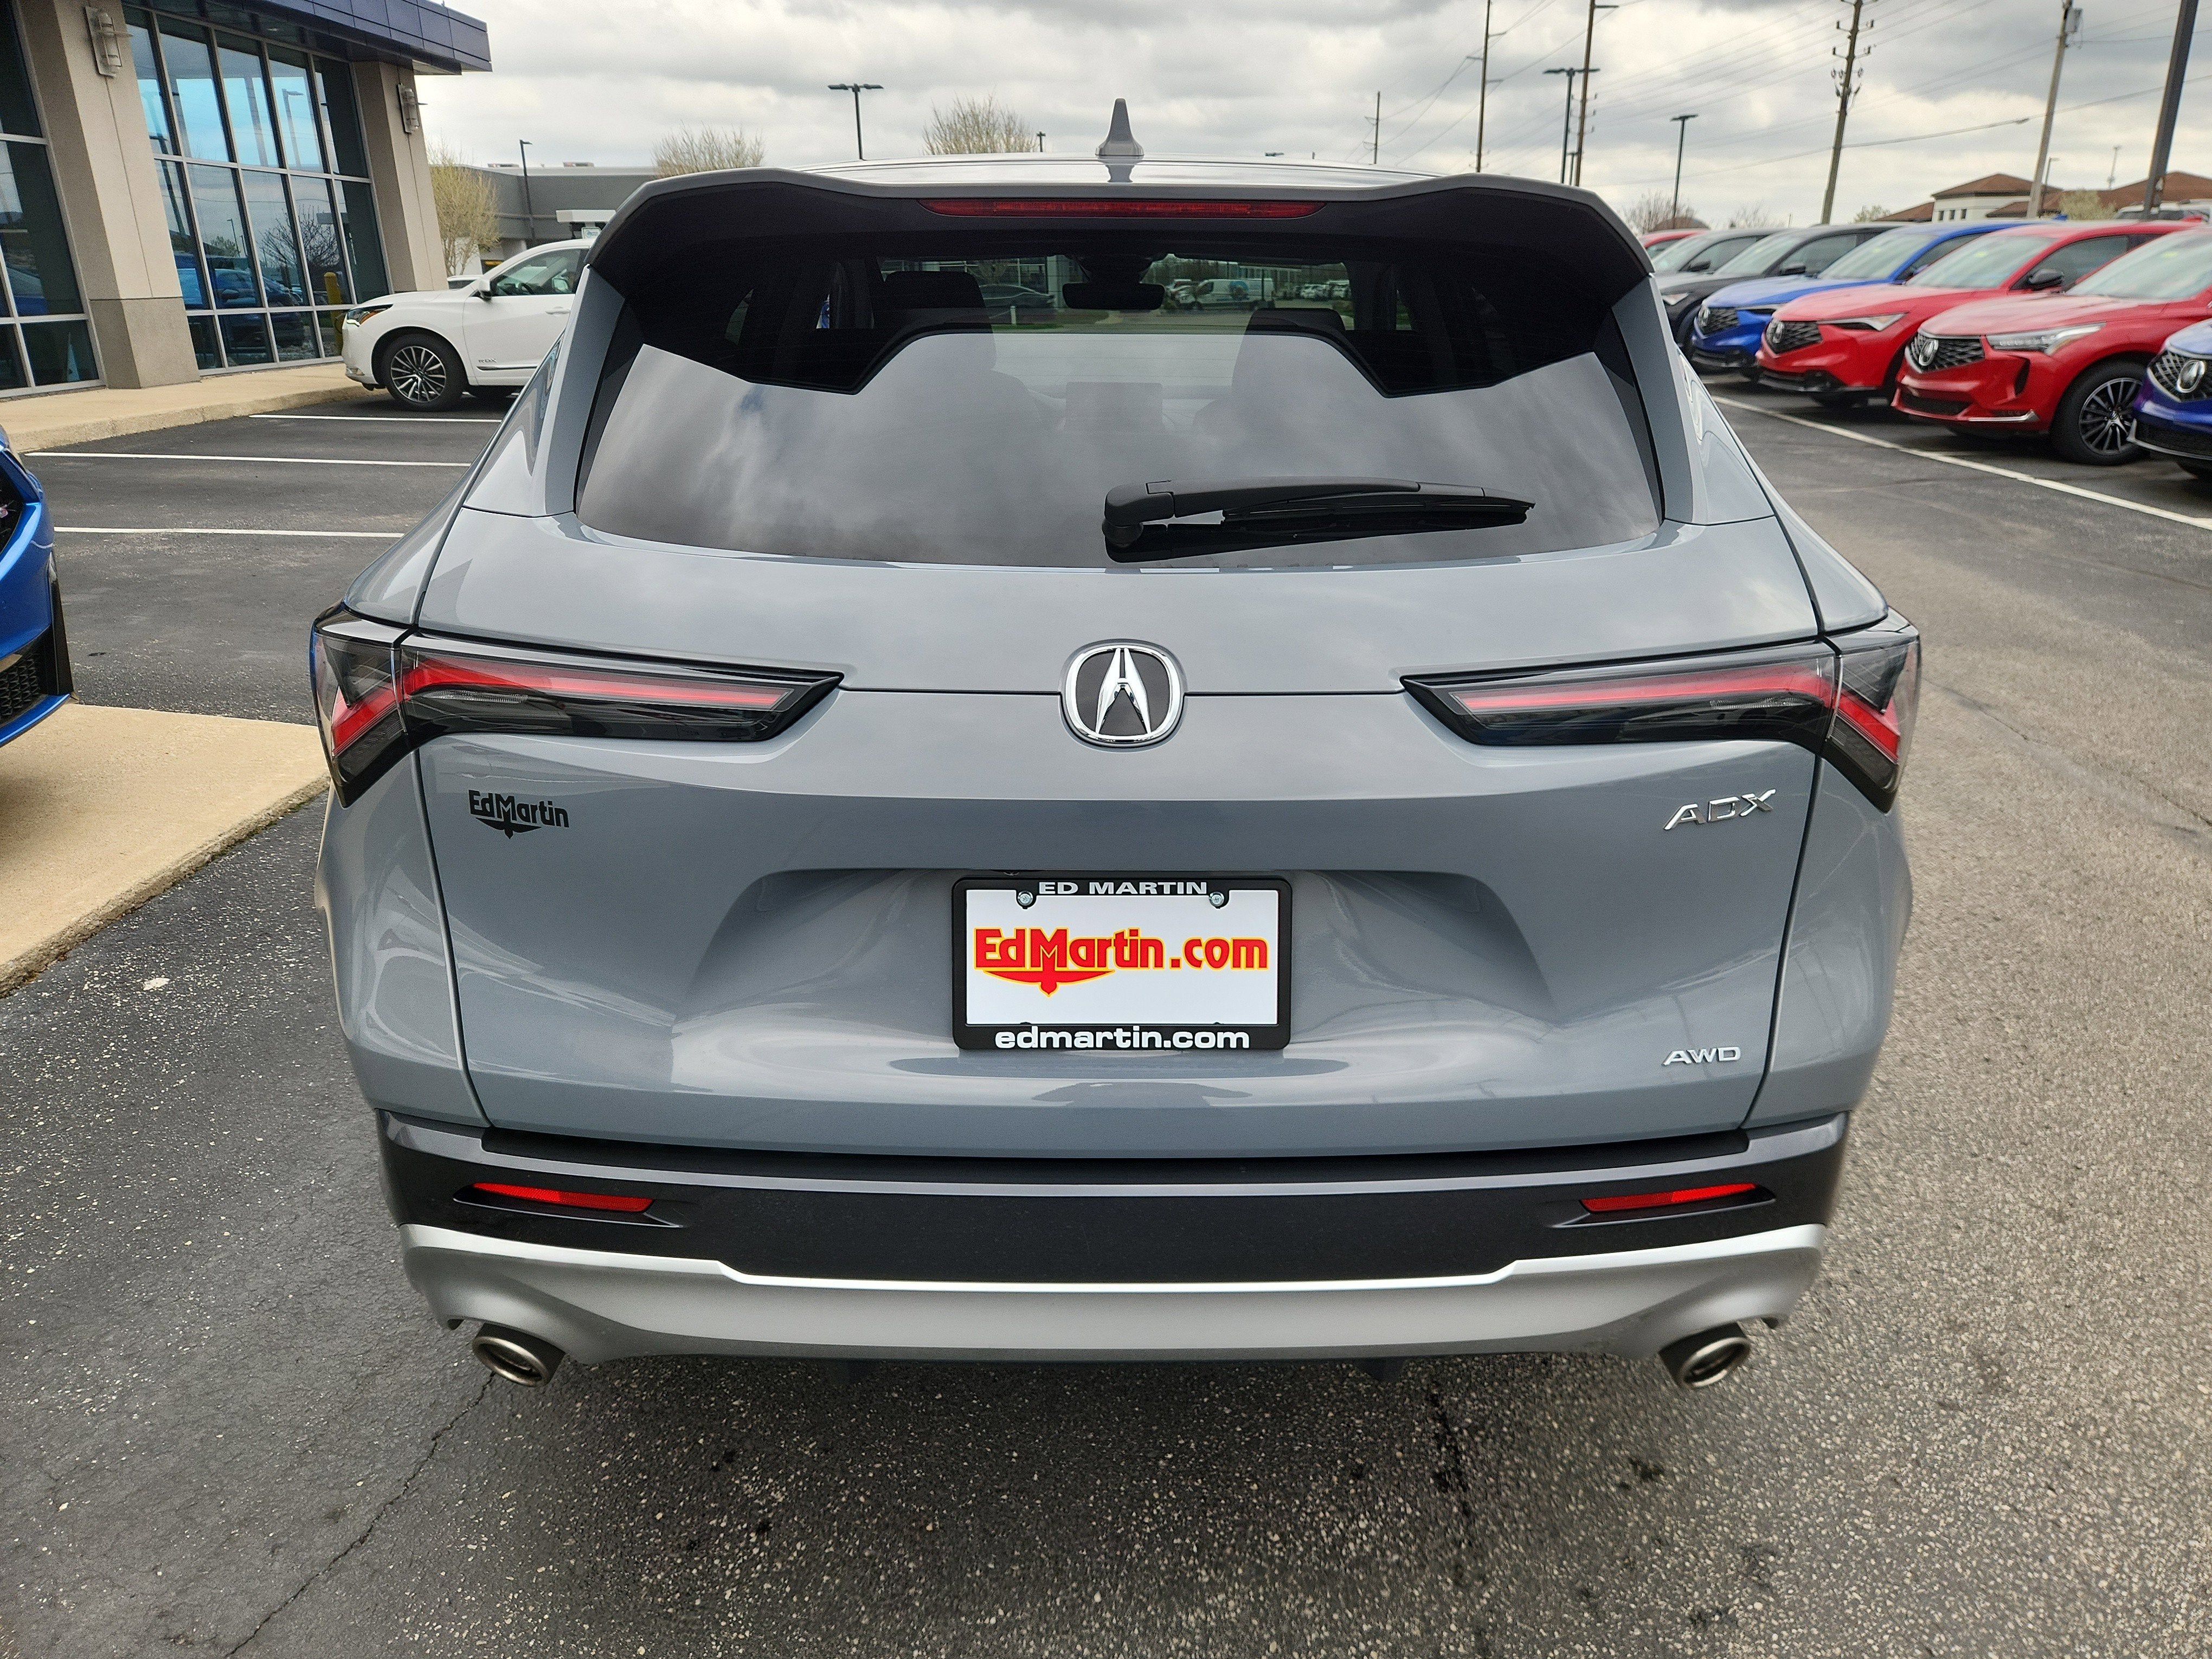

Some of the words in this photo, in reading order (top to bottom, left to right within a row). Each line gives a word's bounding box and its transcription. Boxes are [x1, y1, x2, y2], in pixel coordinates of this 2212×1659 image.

[1662, 788, 1776, 831] ADX
[1039, 882, 1078, 895] ED
[1089, 882, 1207, 895] MARTIN
[995, 1025, 1250, 1049] edmartin.com
[1661, 1046, 1741, 1066] AWD
